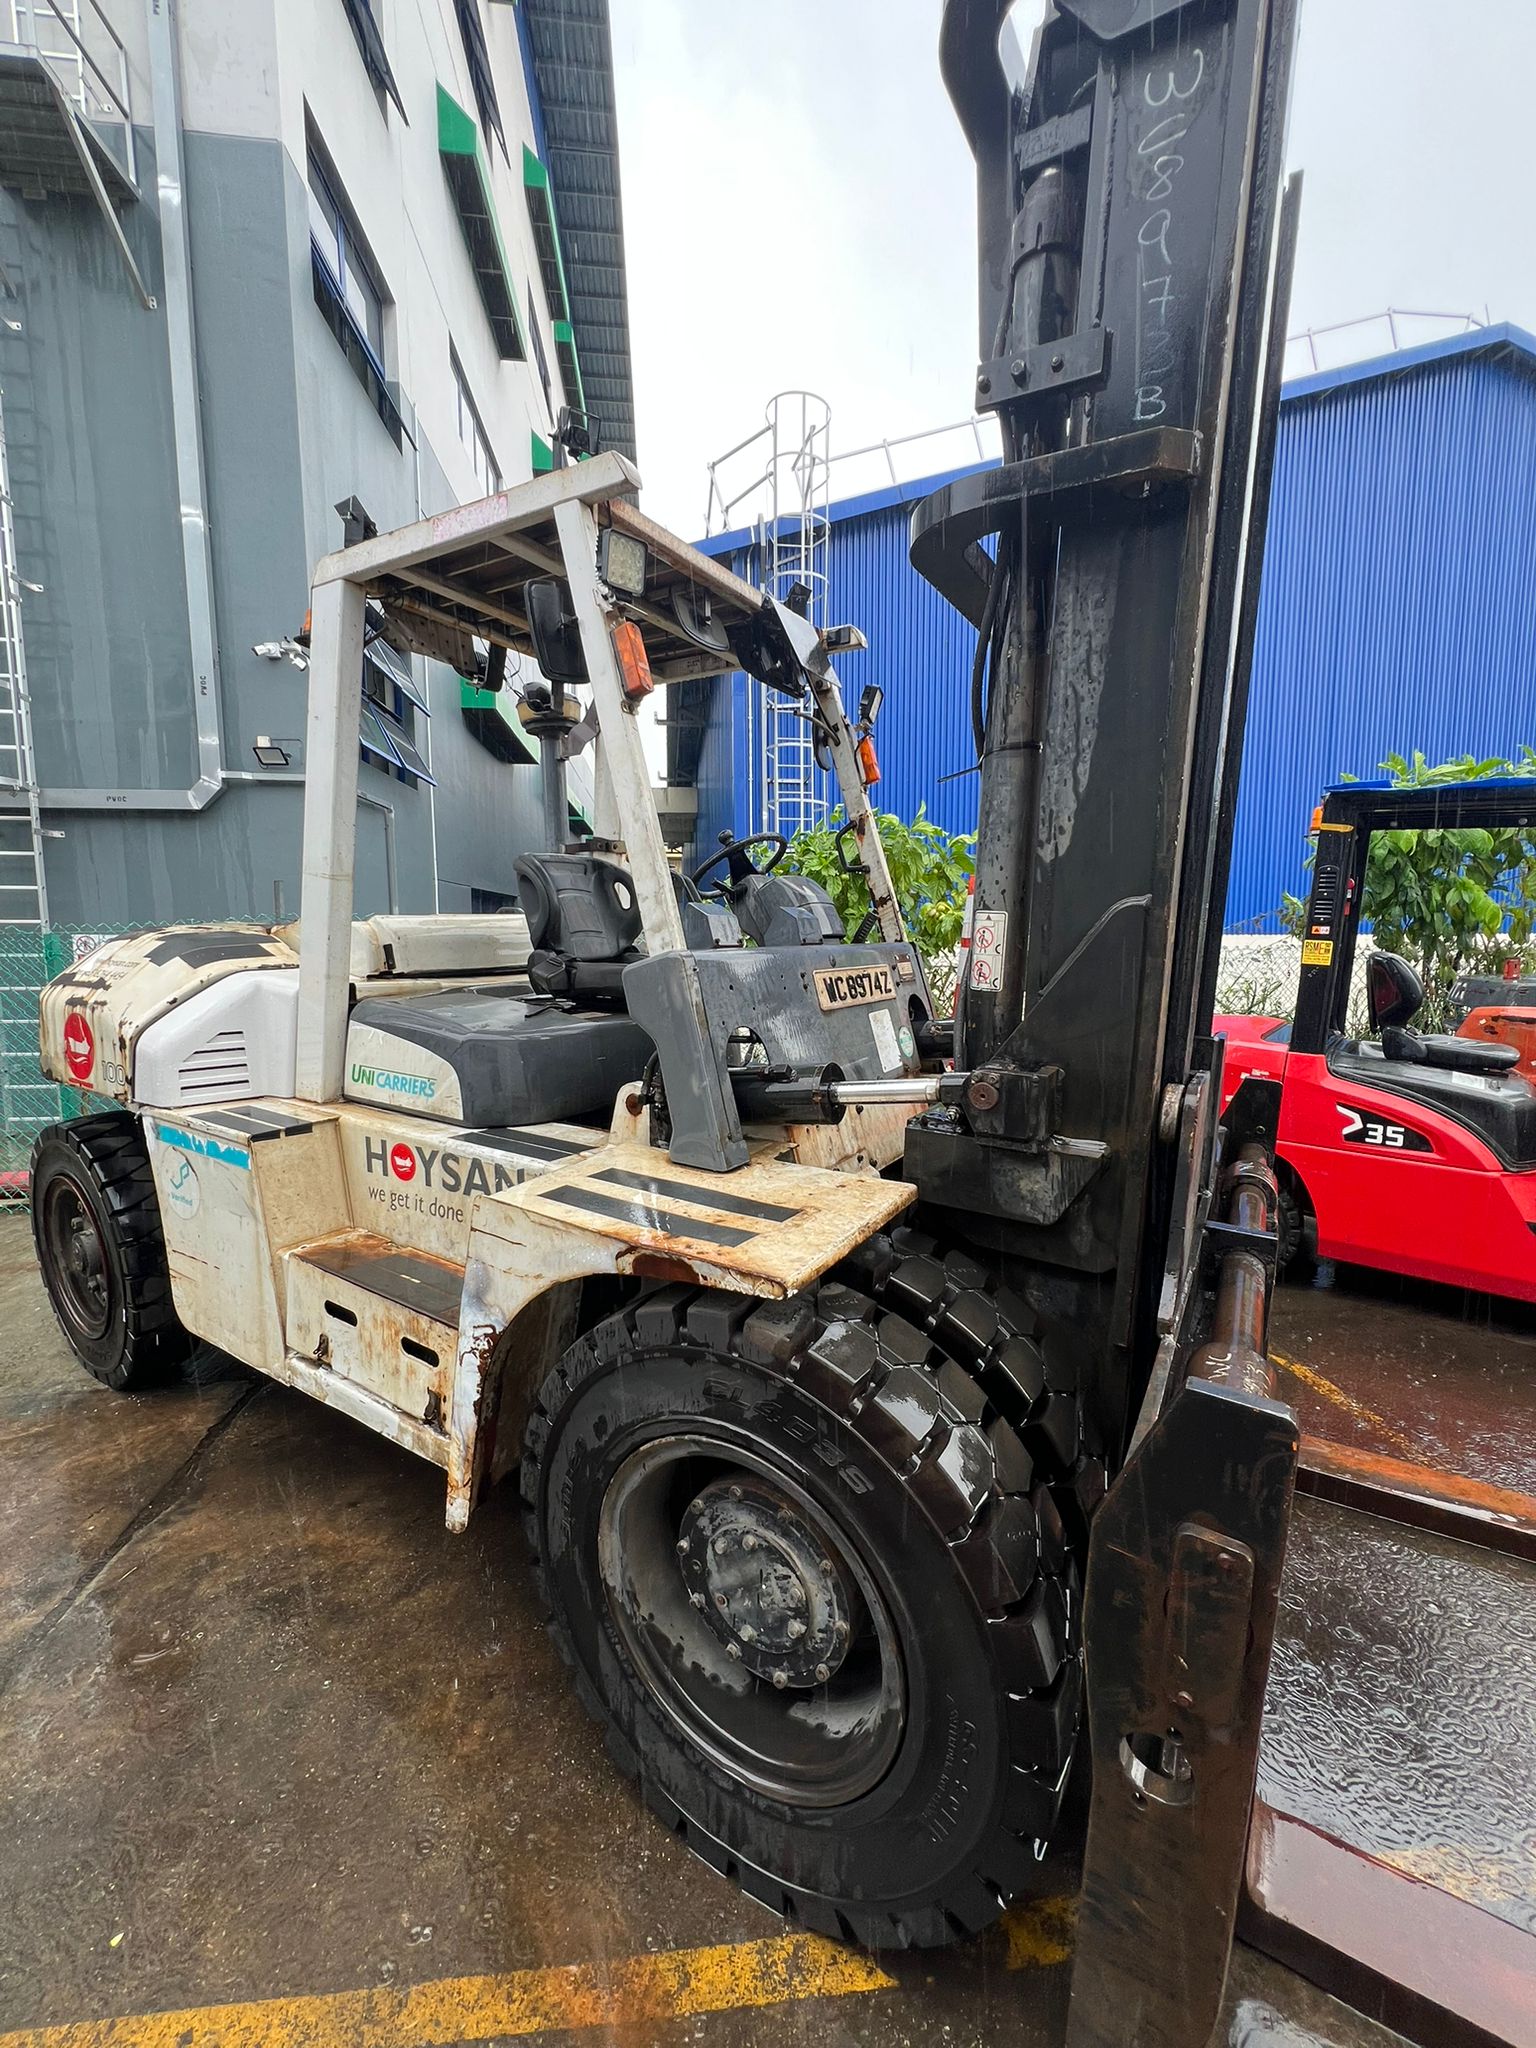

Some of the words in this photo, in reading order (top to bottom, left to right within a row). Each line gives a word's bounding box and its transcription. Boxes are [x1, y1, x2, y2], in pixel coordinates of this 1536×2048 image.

[102, 1060, 125, 1085] 100
[1365, 1123, 1405, 1147] 35
[368, 1186, 386, 1202] we
[390, 1191, 410, 1211] get
[414, 1193, 425, 1213] it
[429, 1197, 464, 1223] done
